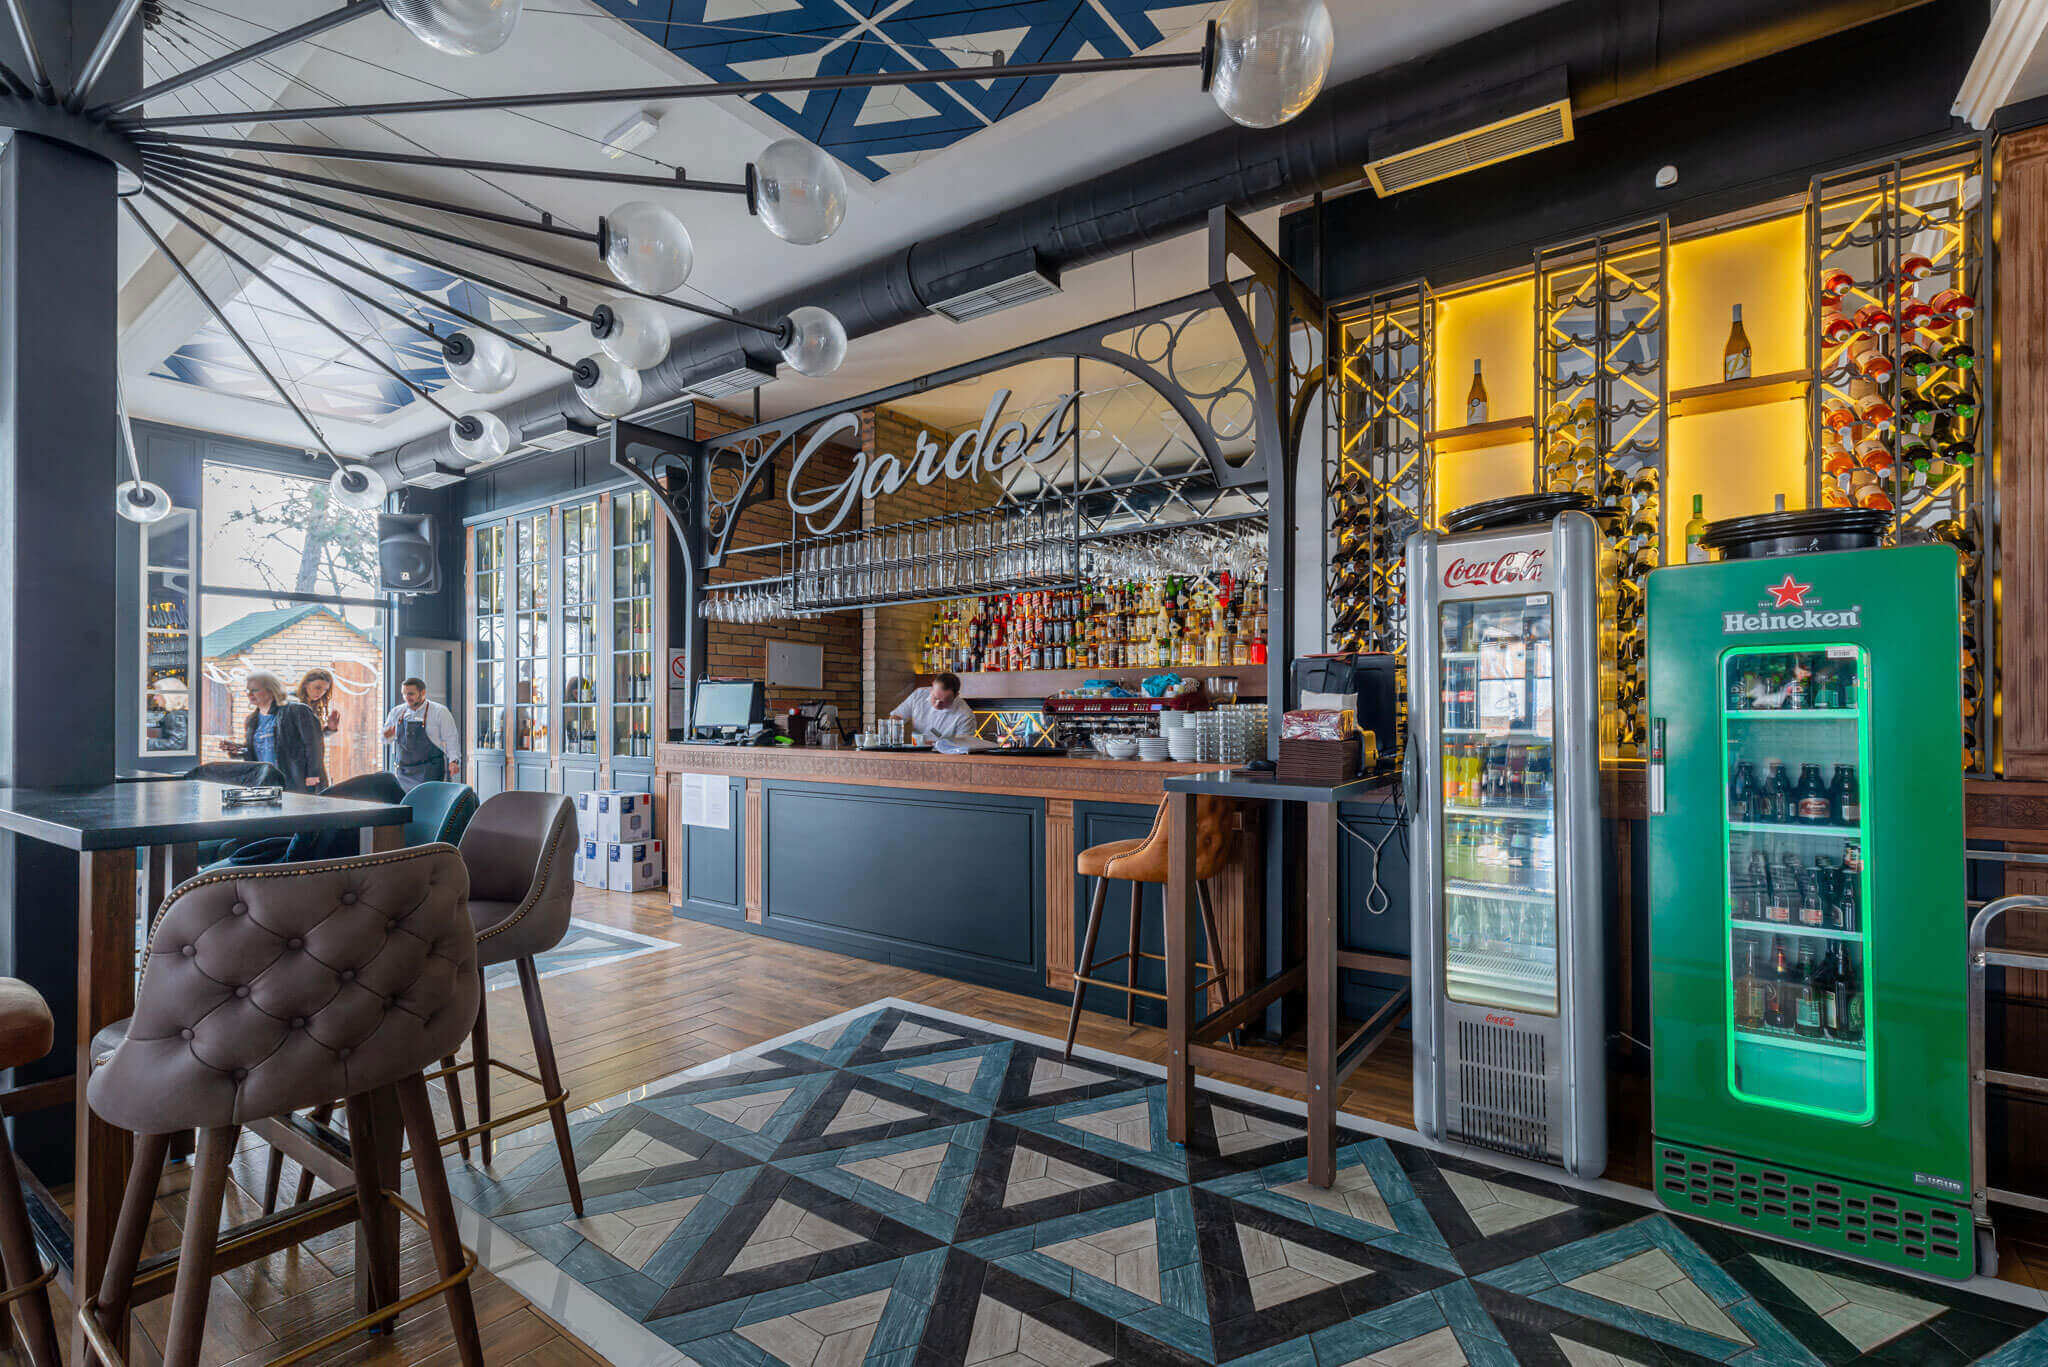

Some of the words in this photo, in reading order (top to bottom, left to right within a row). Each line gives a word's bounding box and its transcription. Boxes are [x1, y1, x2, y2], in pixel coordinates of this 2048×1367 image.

[787, 388, 1084, 535] Gardos
[1443, 549, 1546, 588] Coca-Cola
[1723, 606, 1860, 632] Heineken
